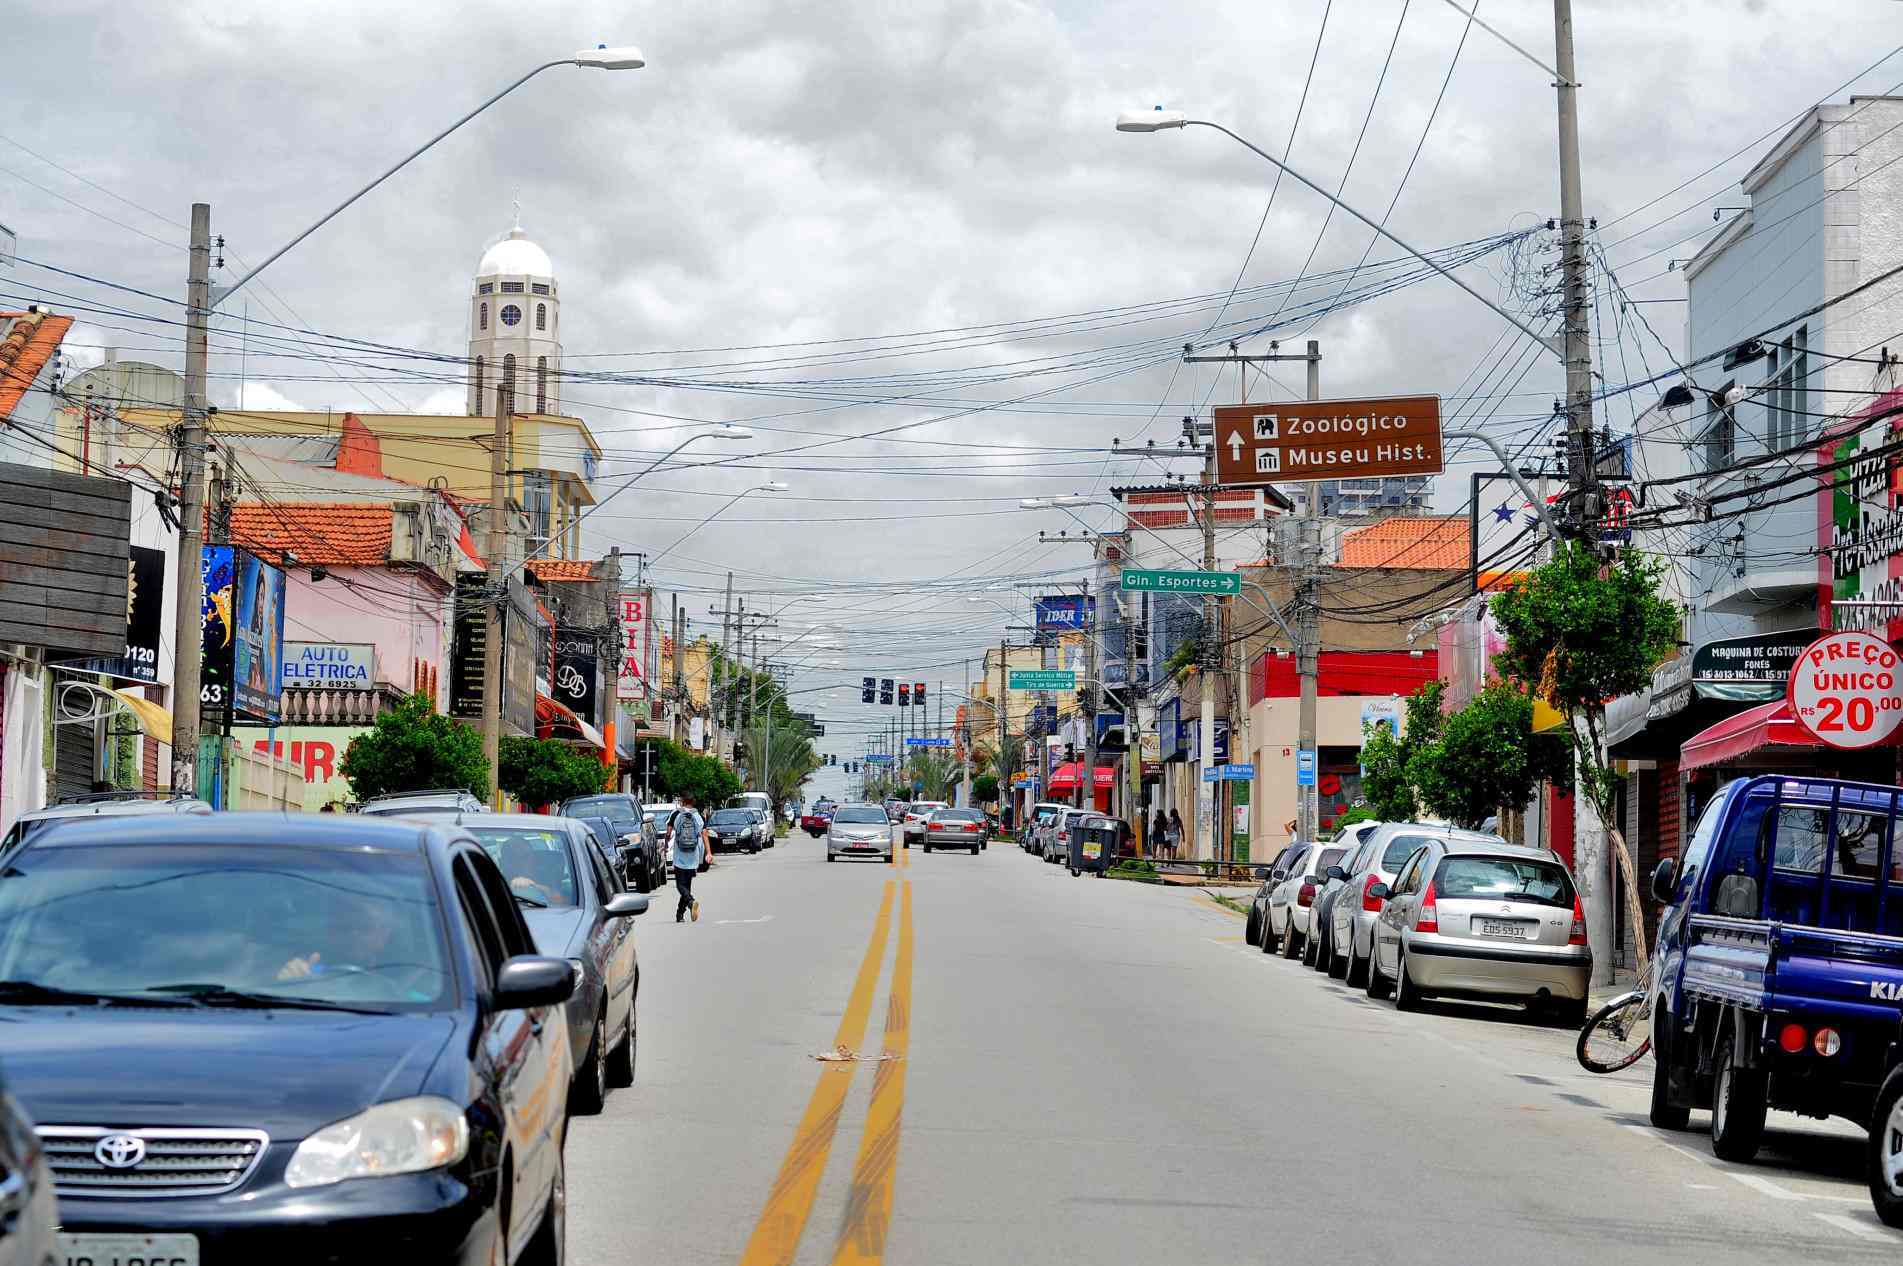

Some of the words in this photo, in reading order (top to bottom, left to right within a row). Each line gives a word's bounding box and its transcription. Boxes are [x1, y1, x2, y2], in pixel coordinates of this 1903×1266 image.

[1287, 413, 1407, 436] Zoológico
[1289, 448, 1369, 466] Museu
[1376, 443, 1432, 462] Hist.
[1126, 575, 1153, 586] Gin.
[1158, 575, 1217, 589] Esportes
[301, 647, 349, 662] AUTO
[1711, 647, 1752, 659] MAQUINA
[1753, 647, 1764, 657] DE
[1809, 641, 1897, 669] PREÇO
[283, 663, 368, 680] ELETRICA
[1813, 669, 1893, 690] ÚNICO
